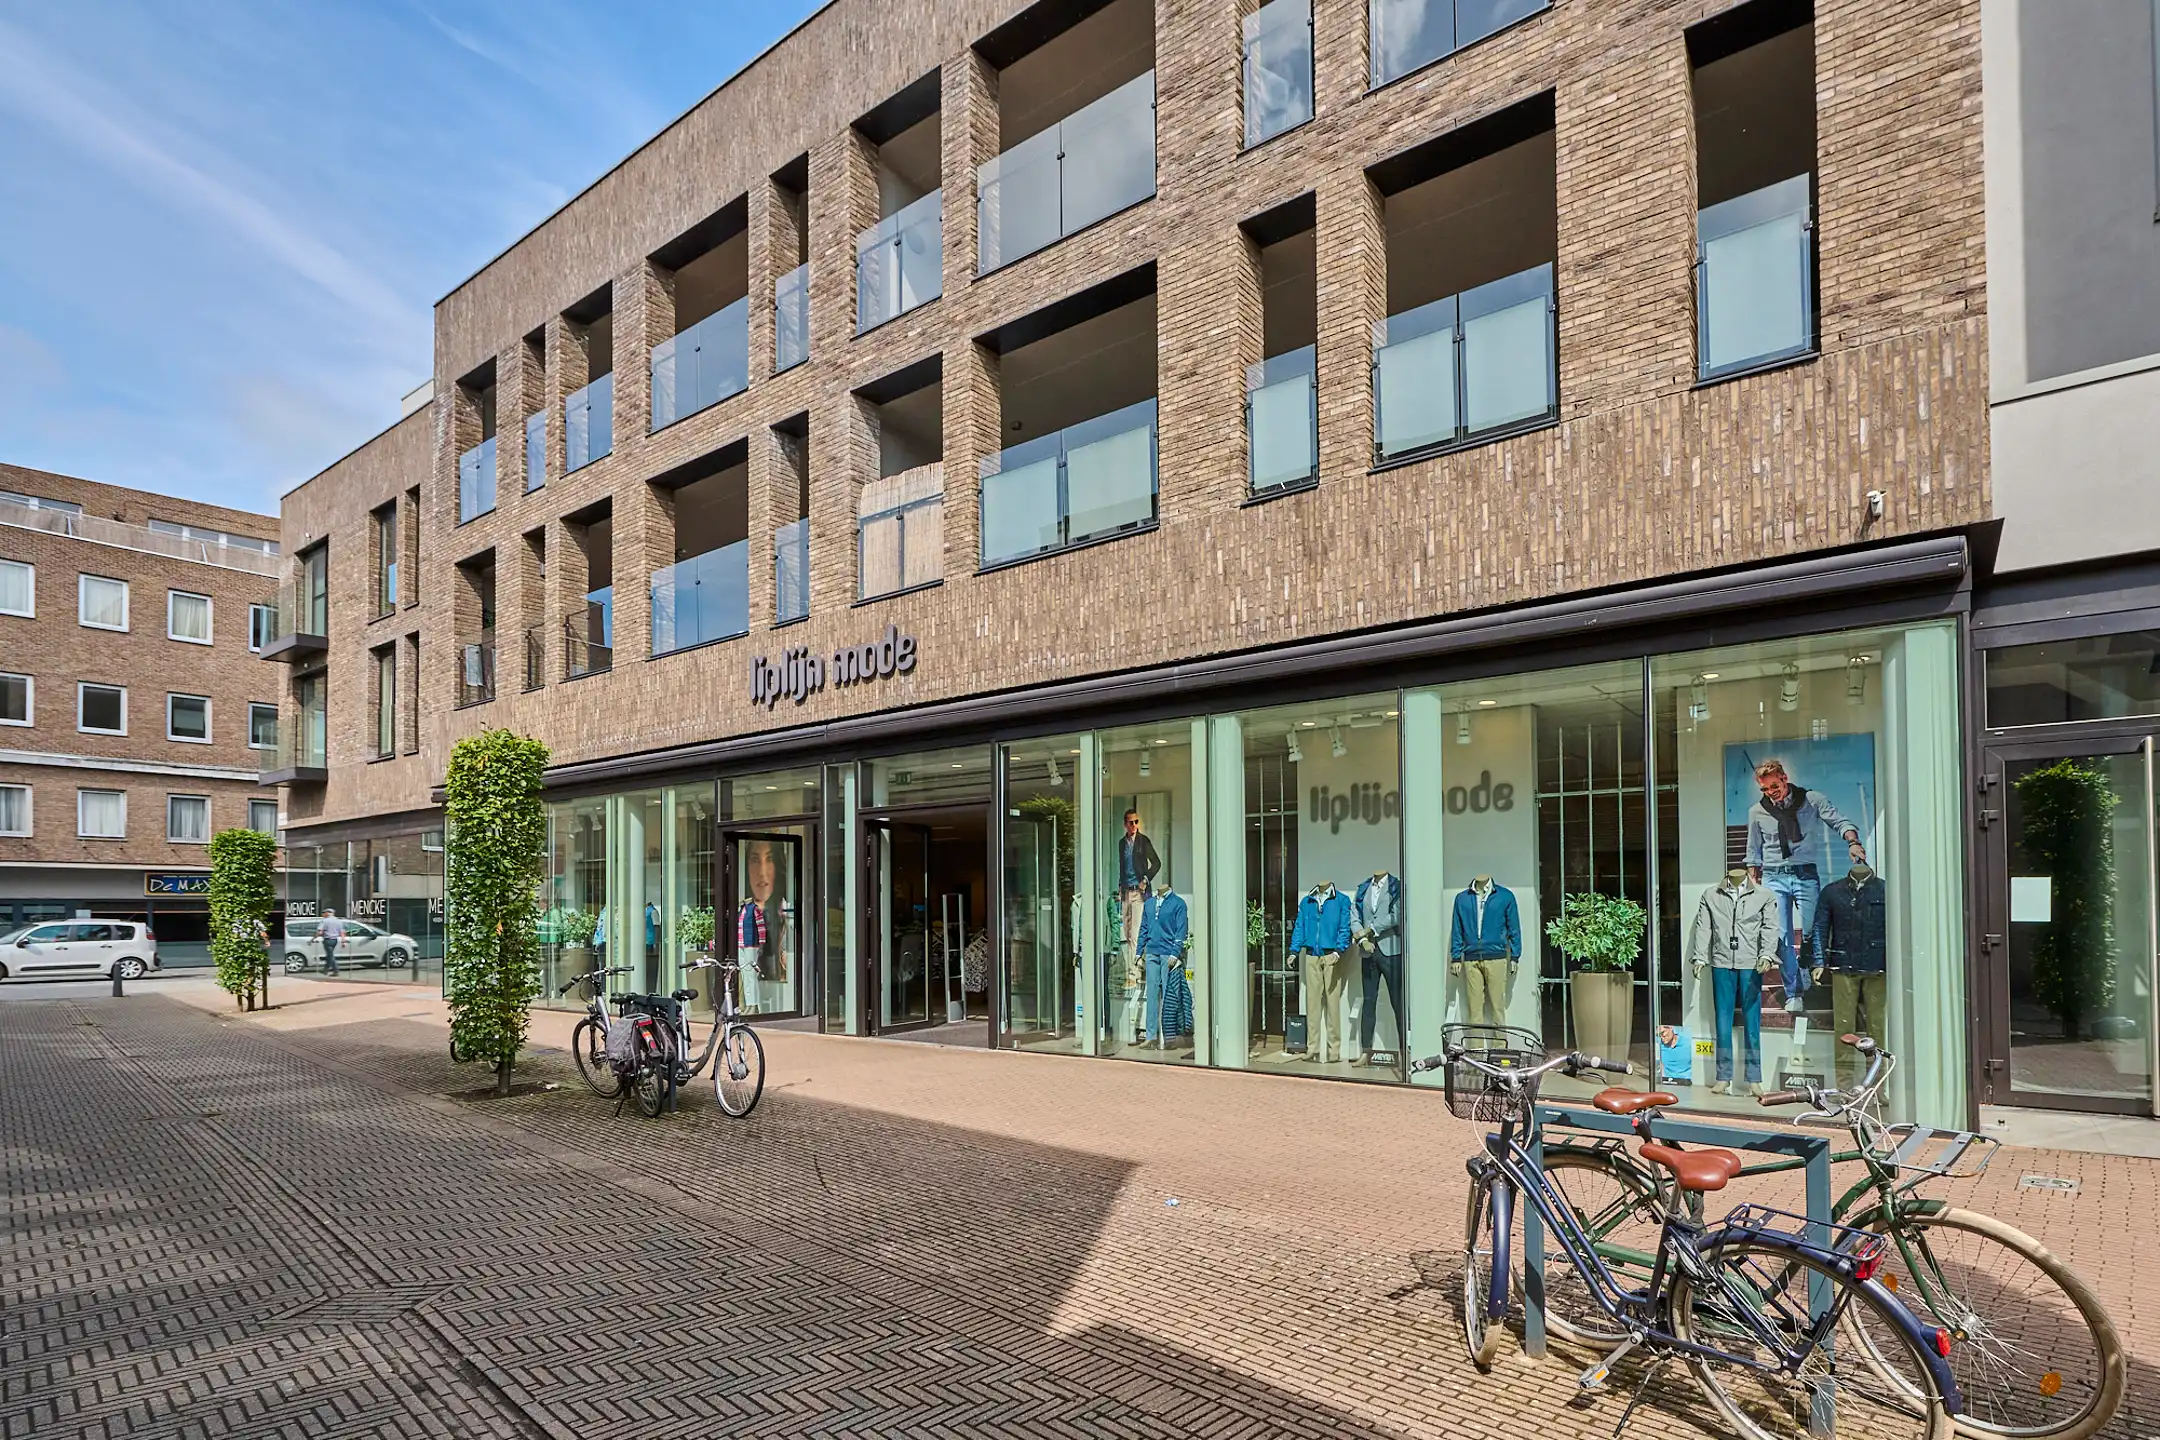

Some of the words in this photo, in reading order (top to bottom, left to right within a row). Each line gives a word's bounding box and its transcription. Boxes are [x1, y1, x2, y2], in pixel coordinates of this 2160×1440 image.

[751, 646, 825, 707] liplijn
[833, 624, 917, 686] mode
[1442, 770, 1514, 815] ode
[150, 879, 173, 892] De
[286, 902, 316, 916] MENCKE
[351, 899, 387, 915] MENCKE
[1785, 1076, 1820, 1087] MEYER
